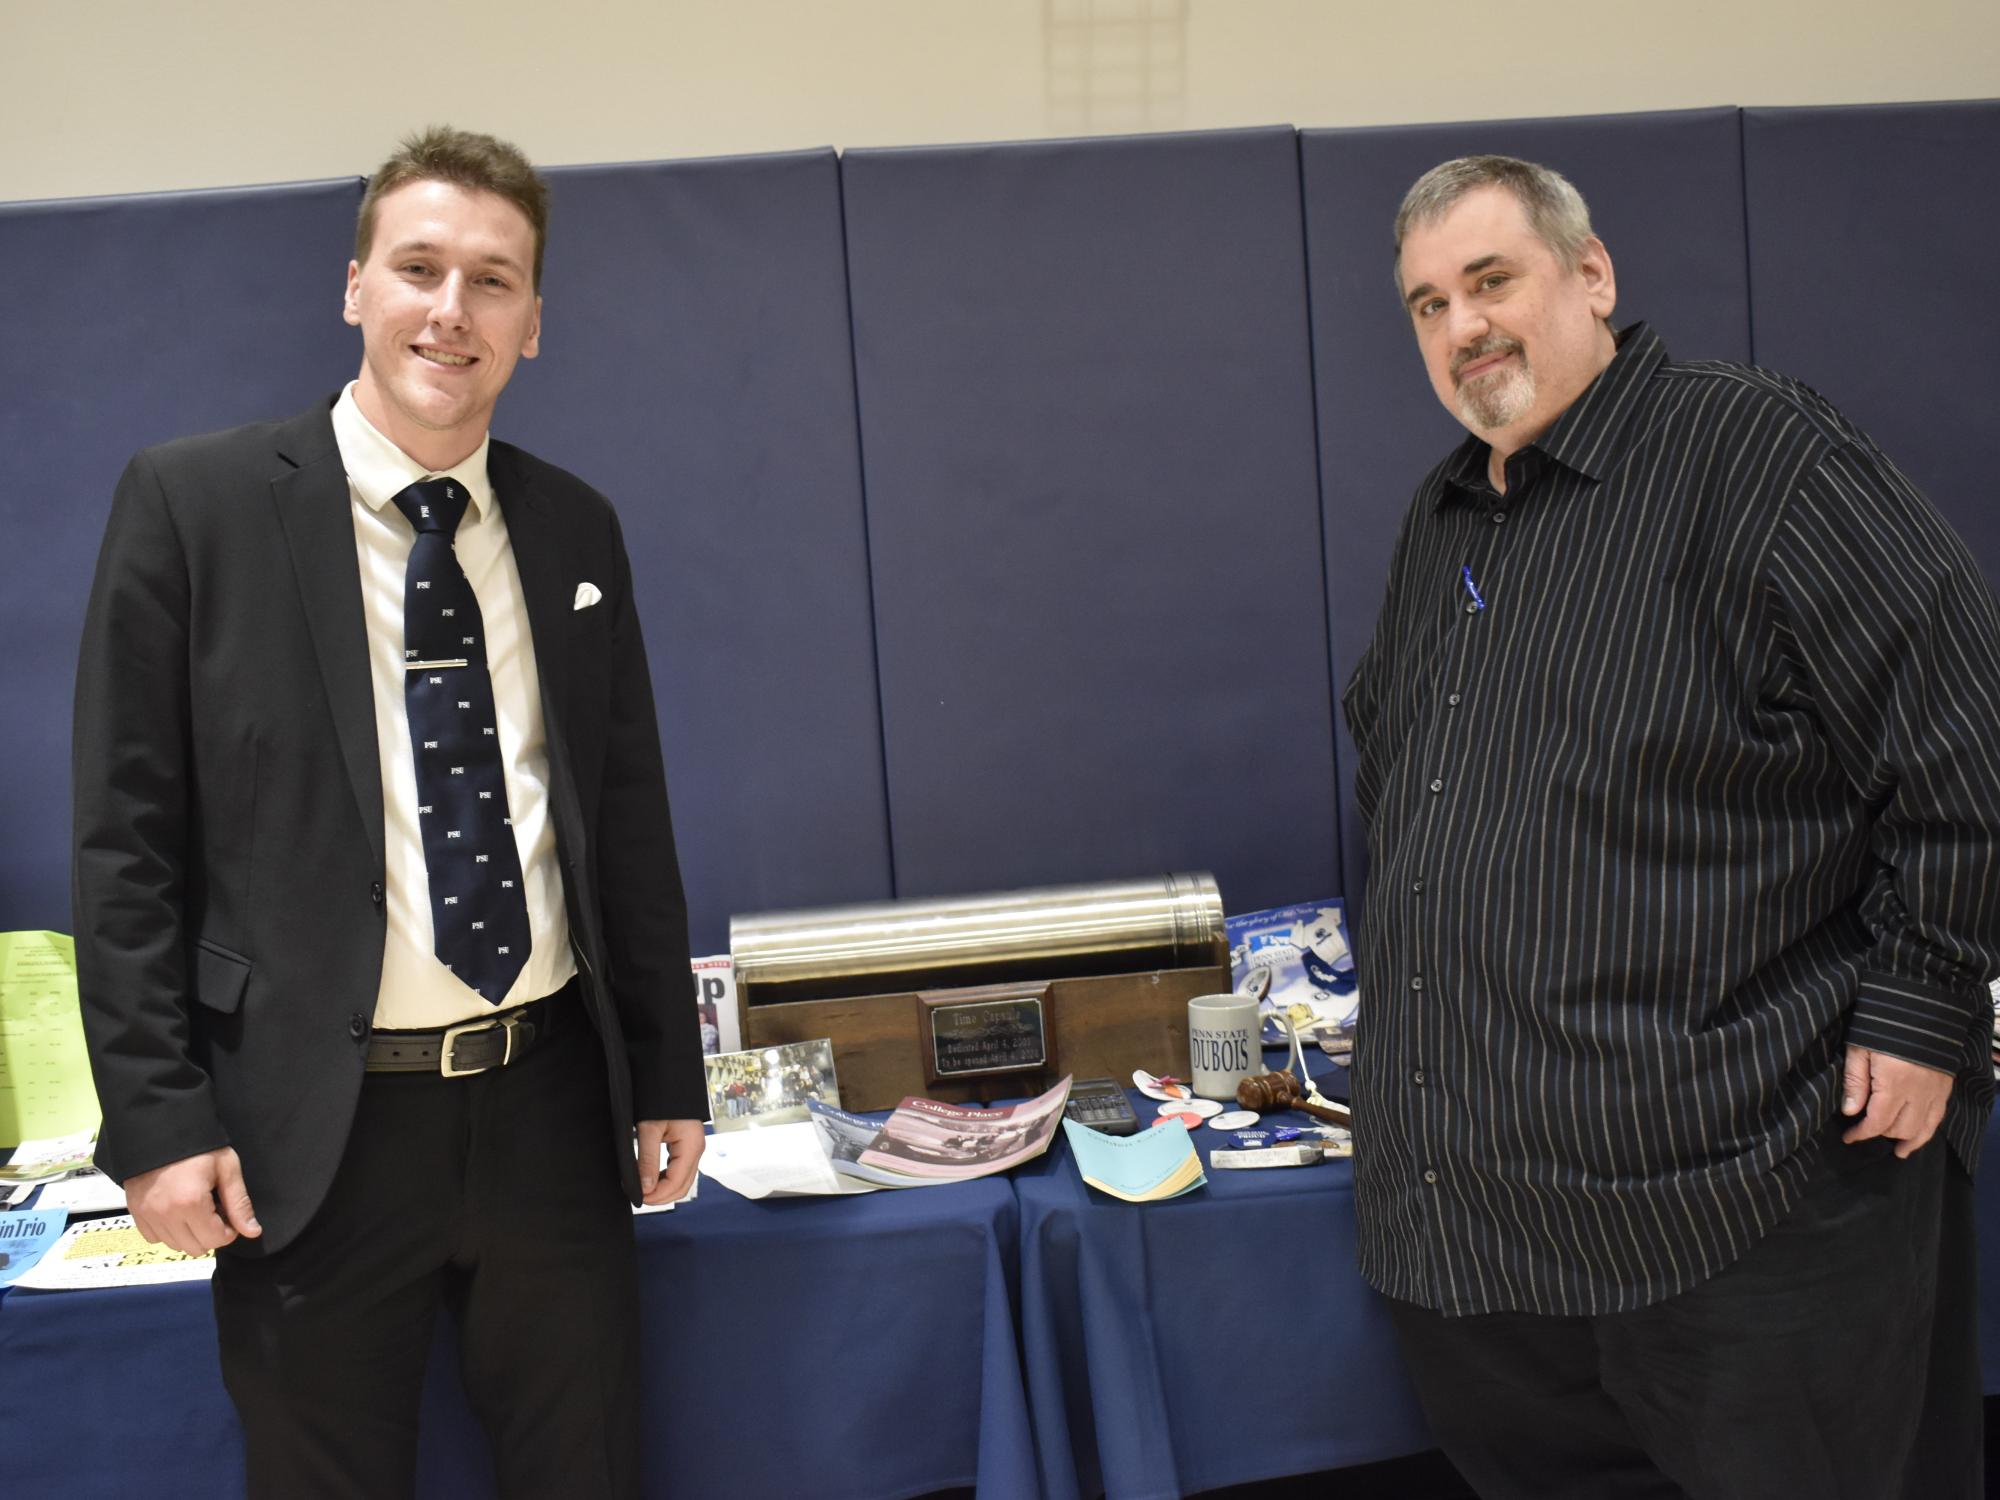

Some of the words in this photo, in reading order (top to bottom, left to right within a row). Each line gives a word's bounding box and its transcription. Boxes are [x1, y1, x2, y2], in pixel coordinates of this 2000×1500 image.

[416, 581, 431, 589] PSU
[441, 608, 455, 617] PSU
[429, 676, 443, 685] PSU
[457, 701, 471, 709] PSU
[423, 740, 438, 749] PSU
[451, 766, 465, 775] PSU
[479, 791, 492, 799] PSU
[419, 806, 433, 814] PSU
[447, 830, 461, 839] PSU
[475, 854, 489, 863] PSU
[501, 880, 514, 888] PSU
[444, 896, 458, 905] PSU
[471, 921, 485, 930] PSU
[497, 946, 510, 955] PSU
[953, 1013, 977, 1026] Time
[1192, 1028, 1213, 1039] PENN
[1215, 1029, 1249, 1040] STATE
[1193, 1037, 1249, 1072] DUBOIS
[911, 1099, 963, 1118] College
[966, 1108, 1004, 1119] Place
[817, 1103, 869, 1127] College
[0, 1217, 46, 1238] inTrio
